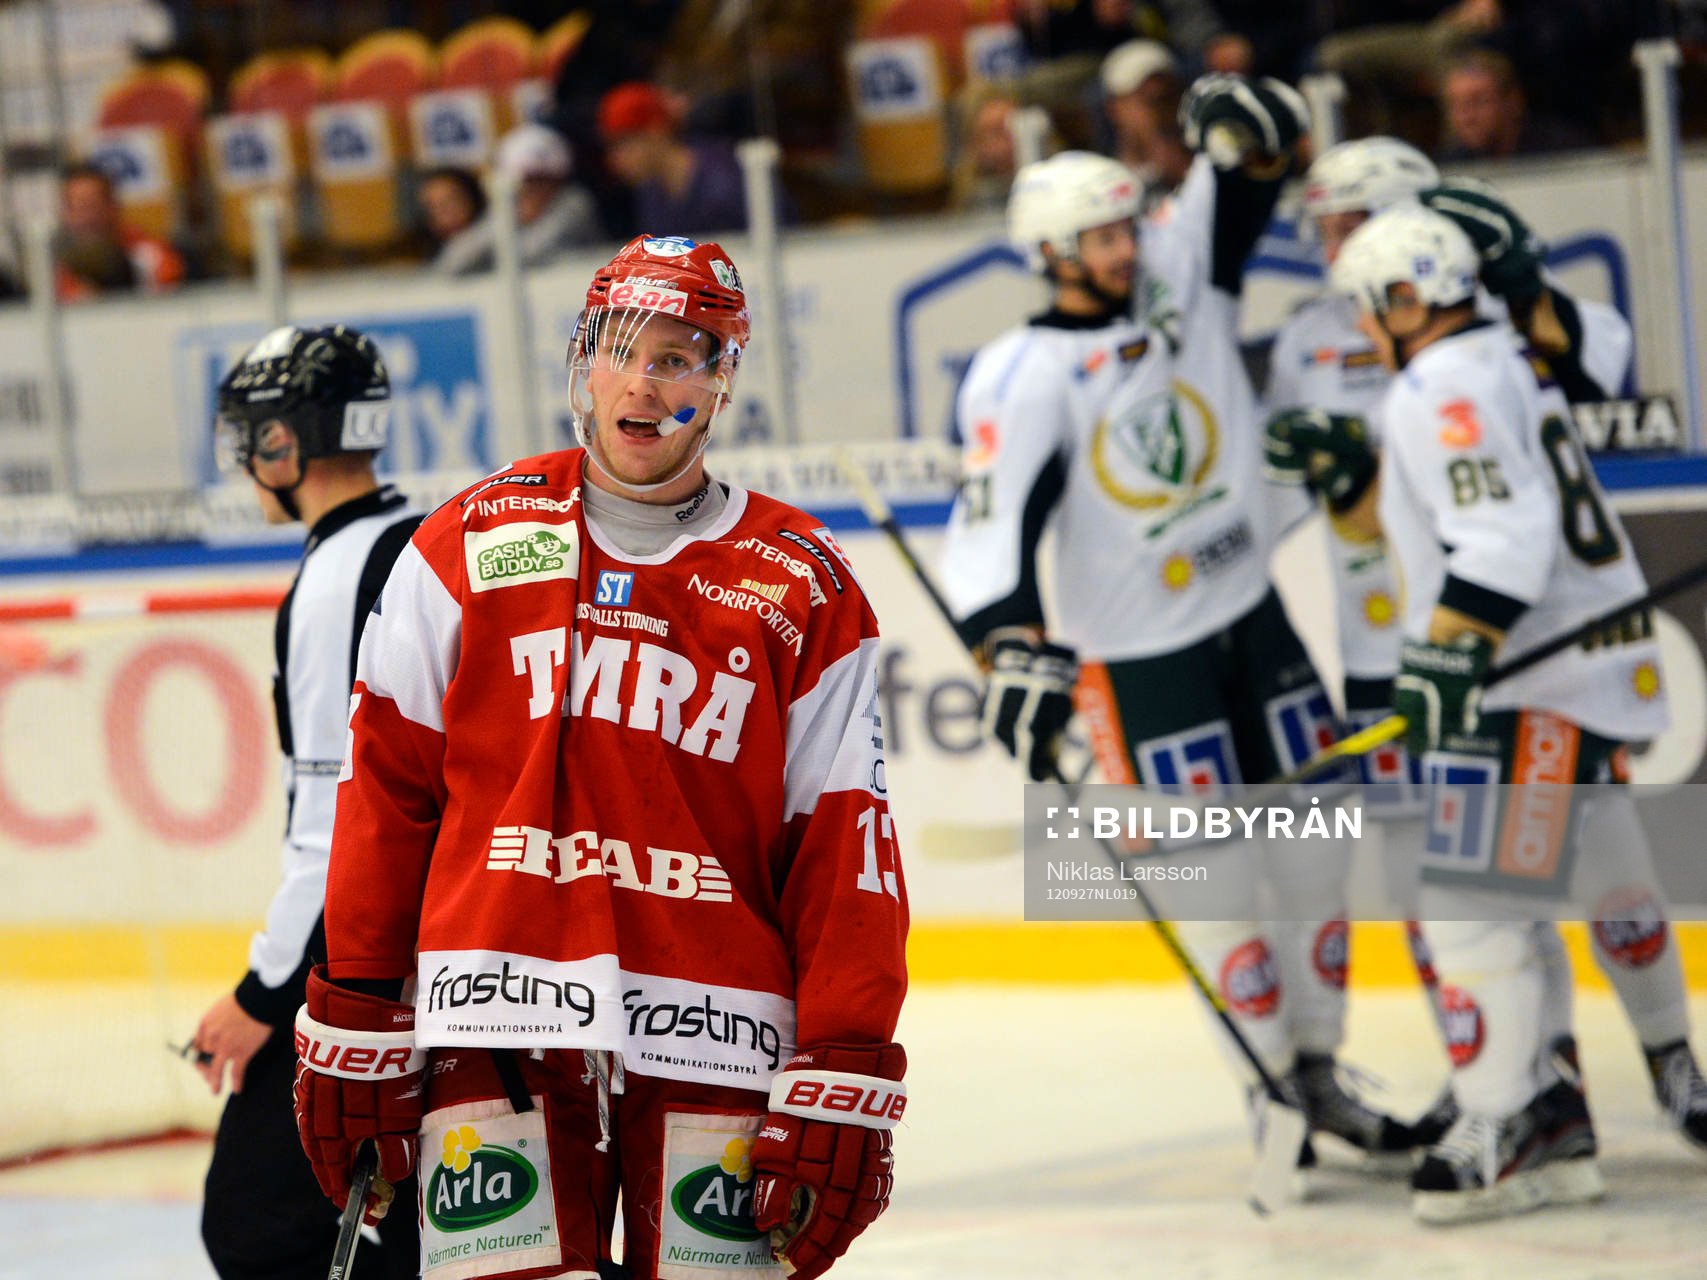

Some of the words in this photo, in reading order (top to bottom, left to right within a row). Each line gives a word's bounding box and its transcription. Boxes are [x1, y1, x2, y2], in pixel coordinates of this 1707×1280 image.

[480, 543, 529, 564] CASH
[597, 572, 631, 603] ST
[622, 611, 669, 637] TIDNING
[687, 573, 804, 656] NORRPORTEN
[509, 626, 757, 763] TMRÅ
[428, 961, 595, 1027] frosting
[447, 1023, 563, 1033] KOMMUNIKATIONSBYRÅ
[295, 1030, 413, 1074] AUER
[641, 1052, 757, 1075] KOMMUNIKATIONSBYRÅ
[435, 1162, 512, 1215] Arla
[476, 1232, 542, 1252] Naturen
[667, 1246, 741, 1265] Närmare
